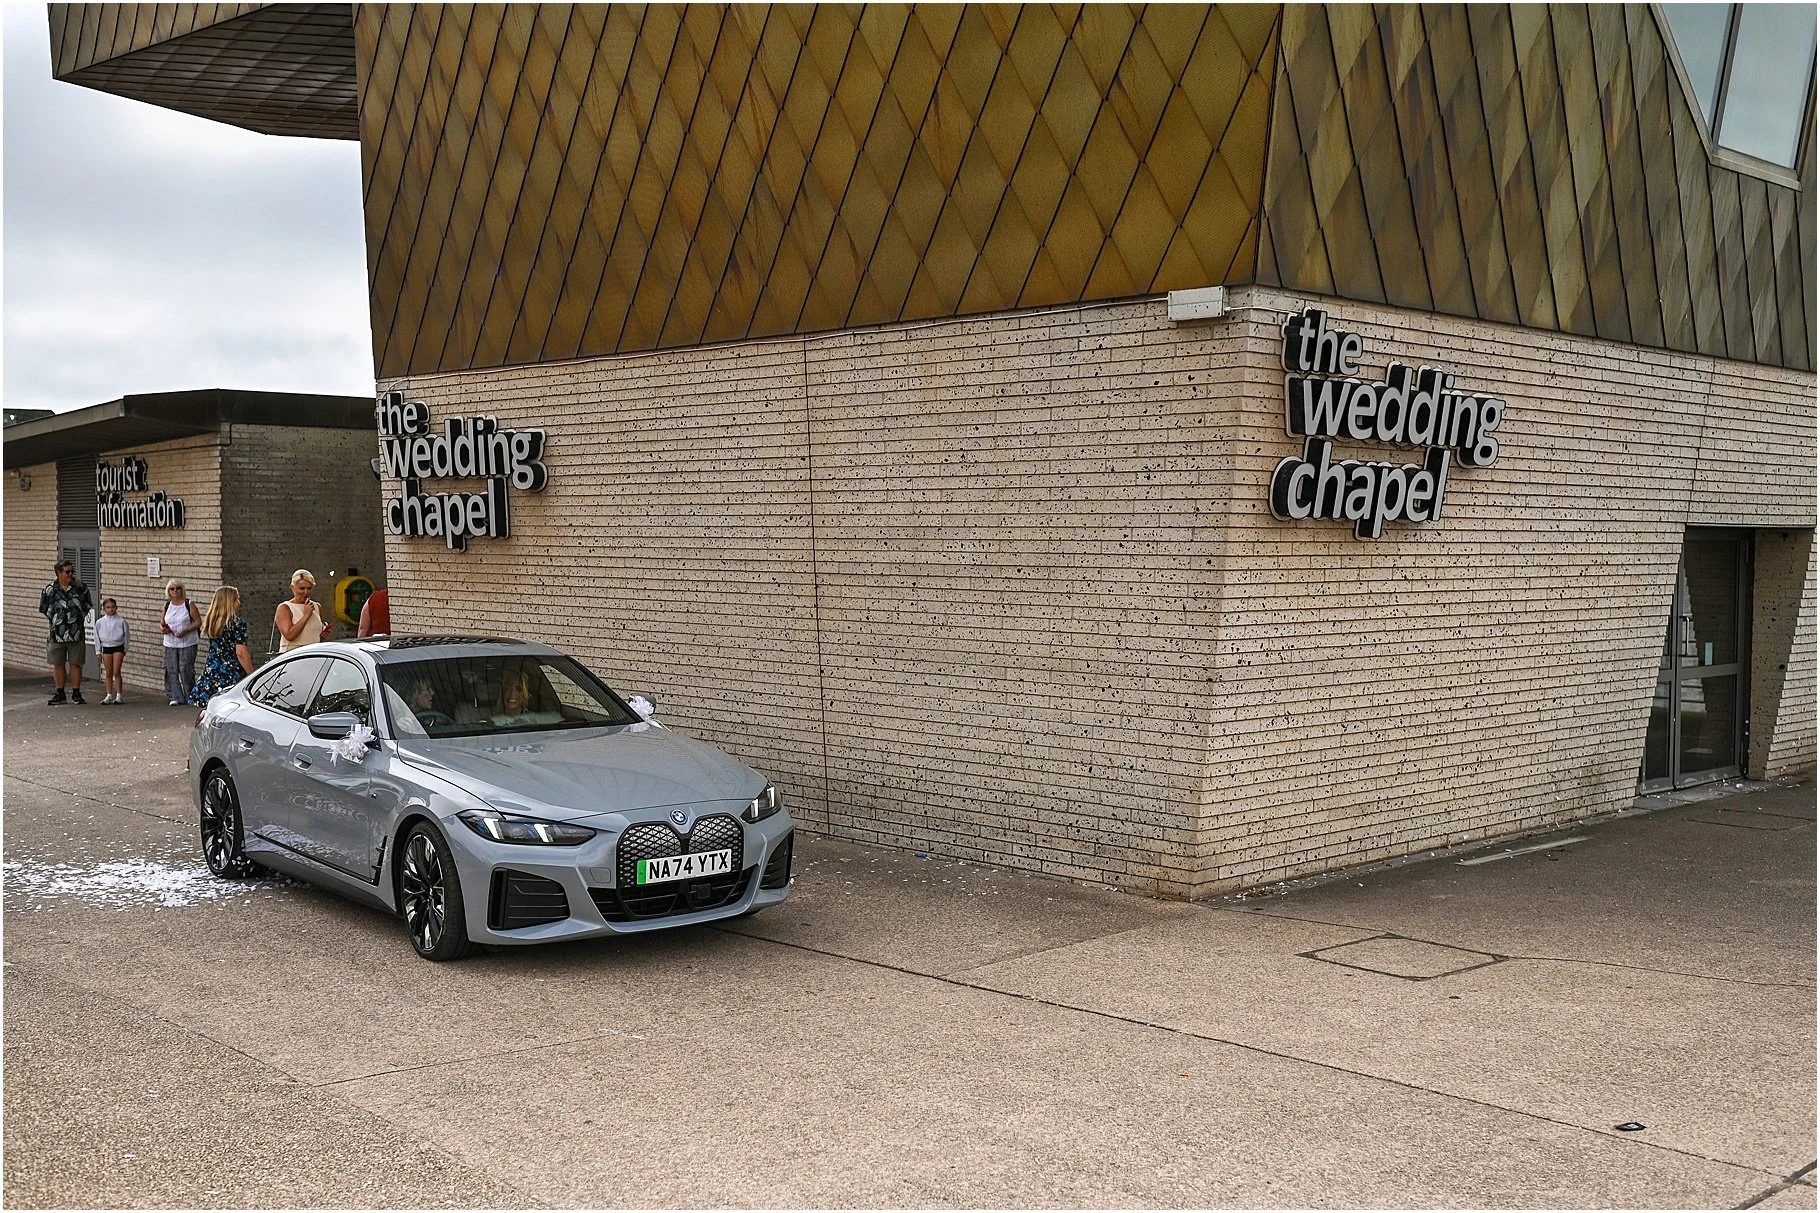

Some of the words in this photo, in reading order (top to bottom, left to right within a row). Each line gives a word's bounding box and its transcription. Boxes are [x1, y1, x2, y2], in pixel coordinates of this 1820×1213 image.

[1299, 311, 1363, 375] the
[377, 392, 418, 435] the
[1303, 367, 1506, 467] wedding
[95, 457, 139, 492] tourist
[381, 418, 535, 490] wedding
[97, 493, 176, 528] information
[387, 478, 497, 549] chapel
[1287, 441, 1451, 539] chapel
[649, 857, 693, 880] NA74
[698, 851, 728, 873] YTX
